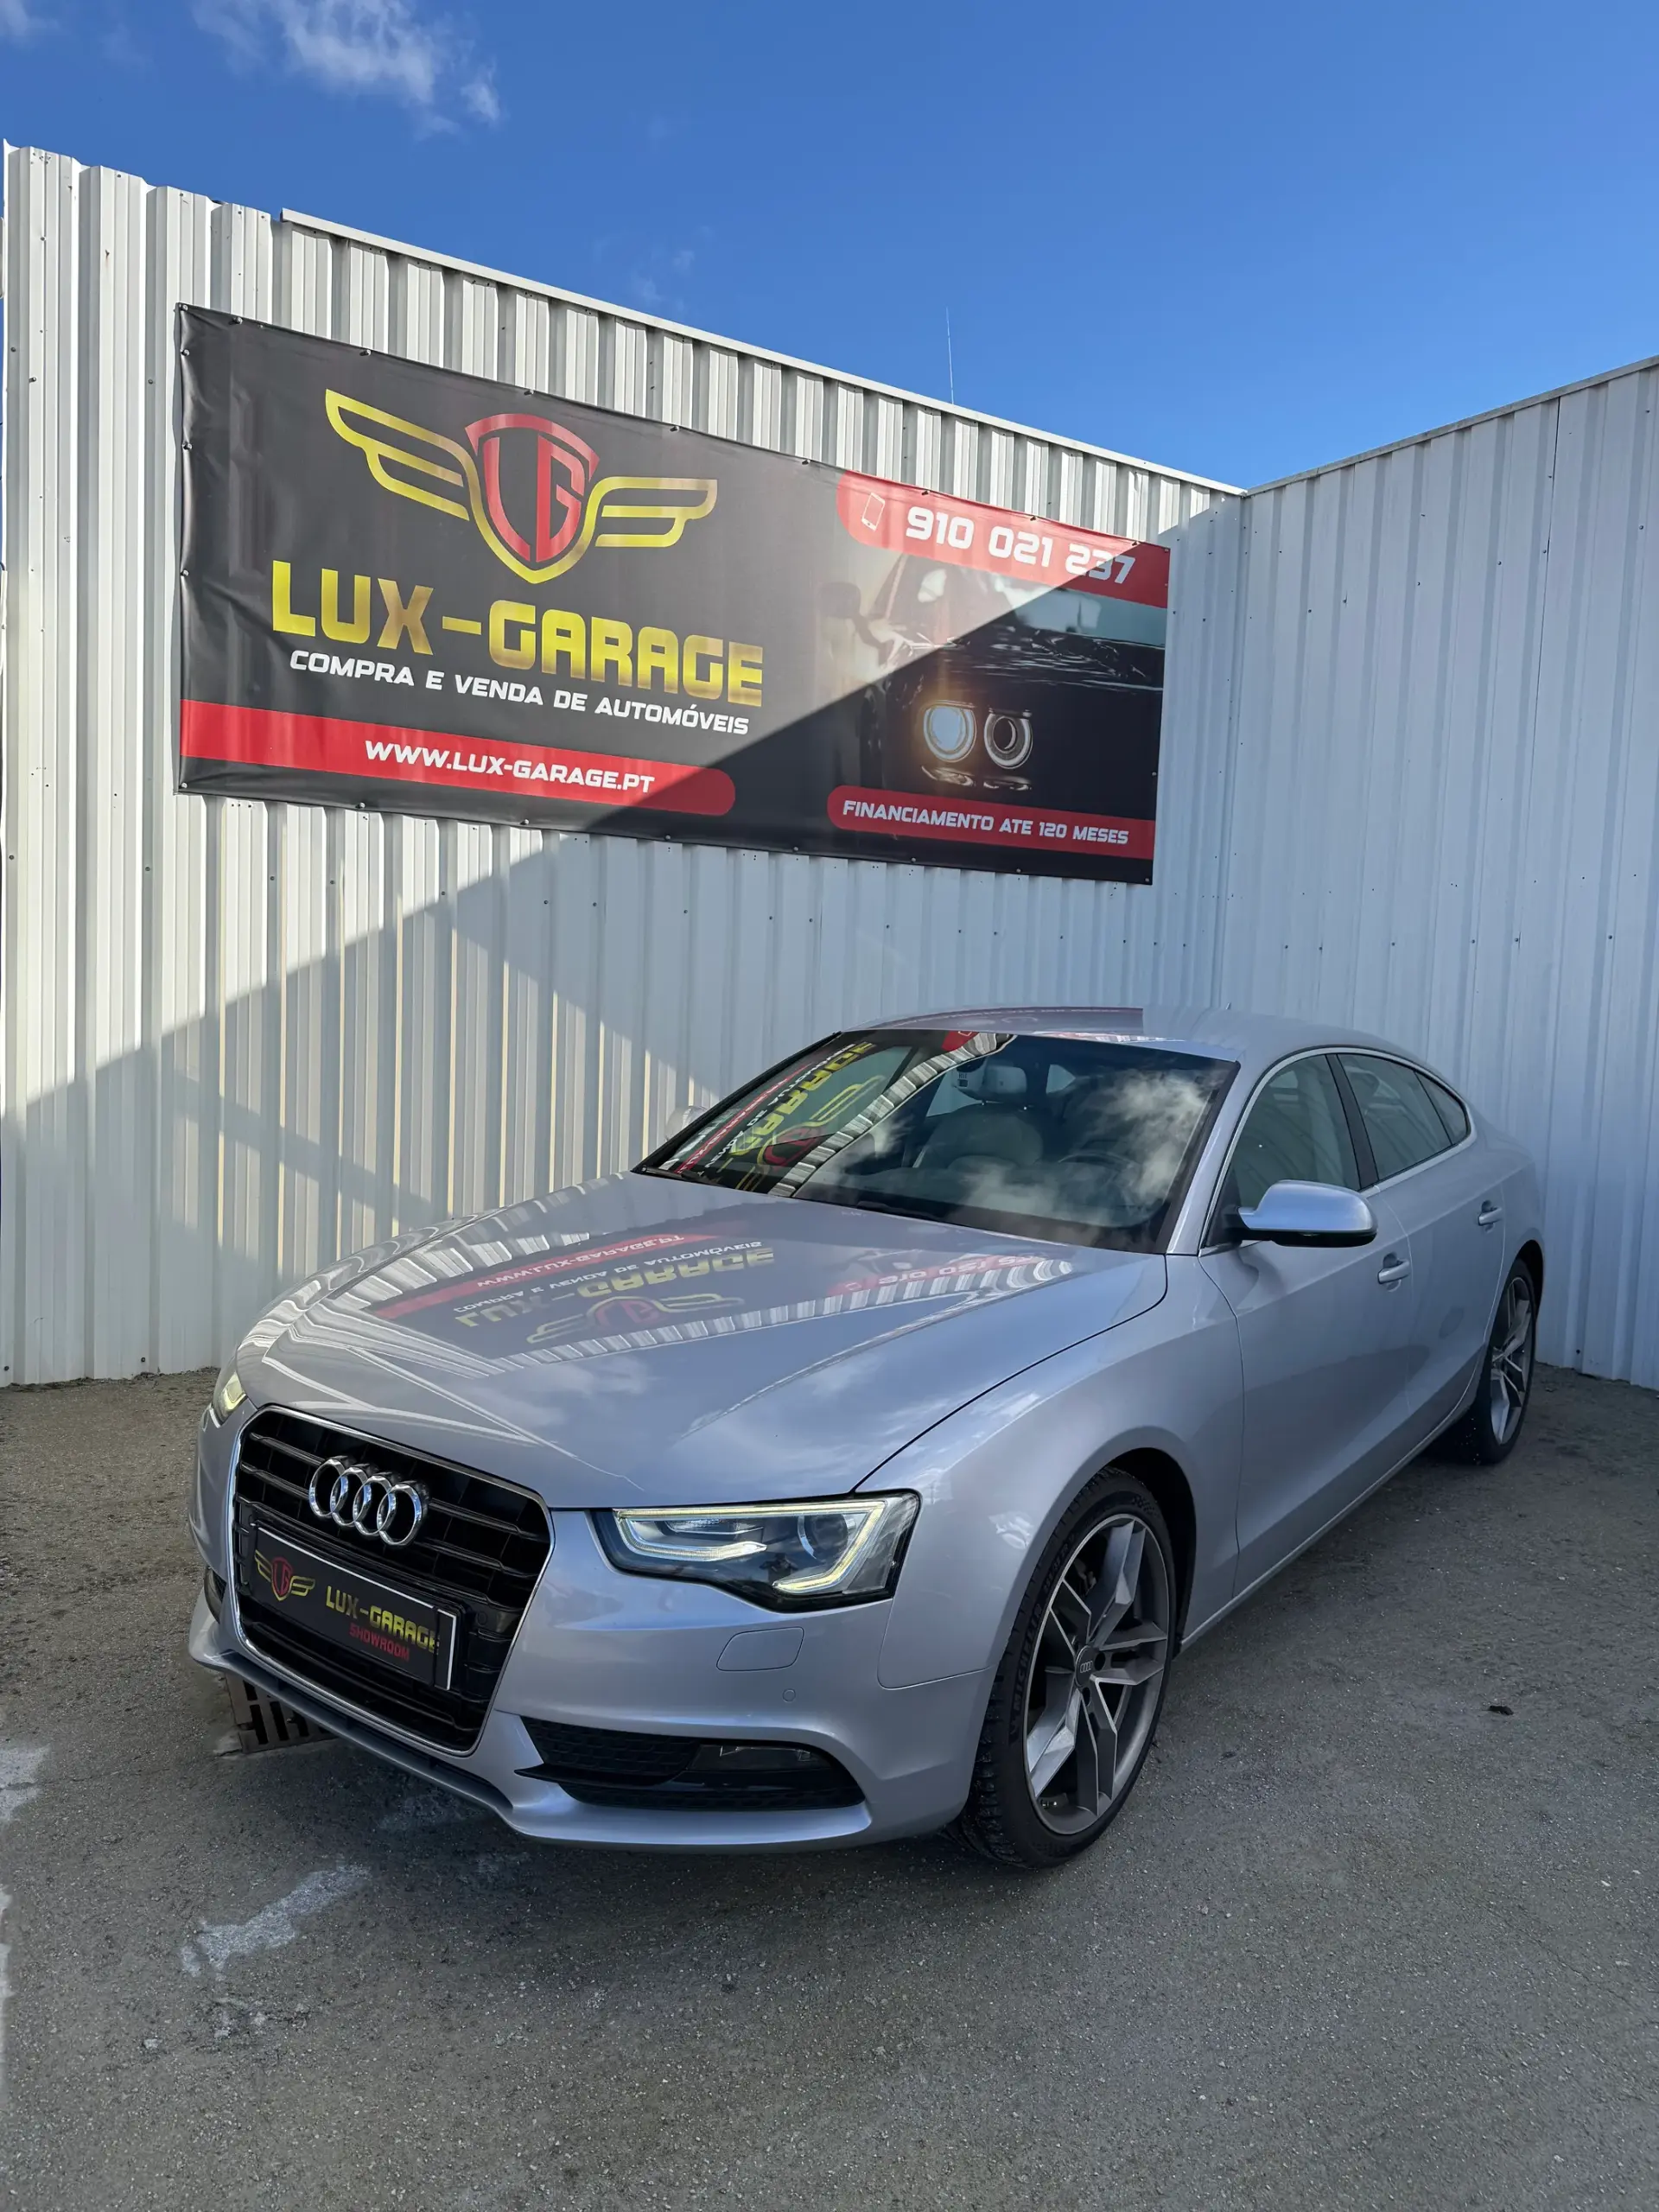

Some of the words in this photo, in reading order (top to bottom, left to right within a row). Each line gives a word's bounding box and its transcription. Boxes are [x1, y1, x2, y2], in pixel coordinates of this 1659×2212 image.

[906, 506, 975, 549] 910
[988, 526, 1053, 568] 021
[1065, 543, 1136, 584] 237
[273, 560, 763, 707] LUX-GARAGE
[290, 650, 415, 686] COMPRA
[425, 670, 445, 690] E
[454, 674, 543, 705] VENDA
[553, 690, 588, 712] DE
[594, 696, 749, 734] AUTOMÓVEIS
[365, 740, 656, 793] WWW.LUX-GARAGE.PT
[842, 800, 995, 830] FINANCIAMENTO
[999, 818, 1033, 836] ATE
[1039, 822, 1068, 839] 120
[1072, 825, 1128, 844] MESES
[348, 1622, 410, 1662] SHOWROOM
